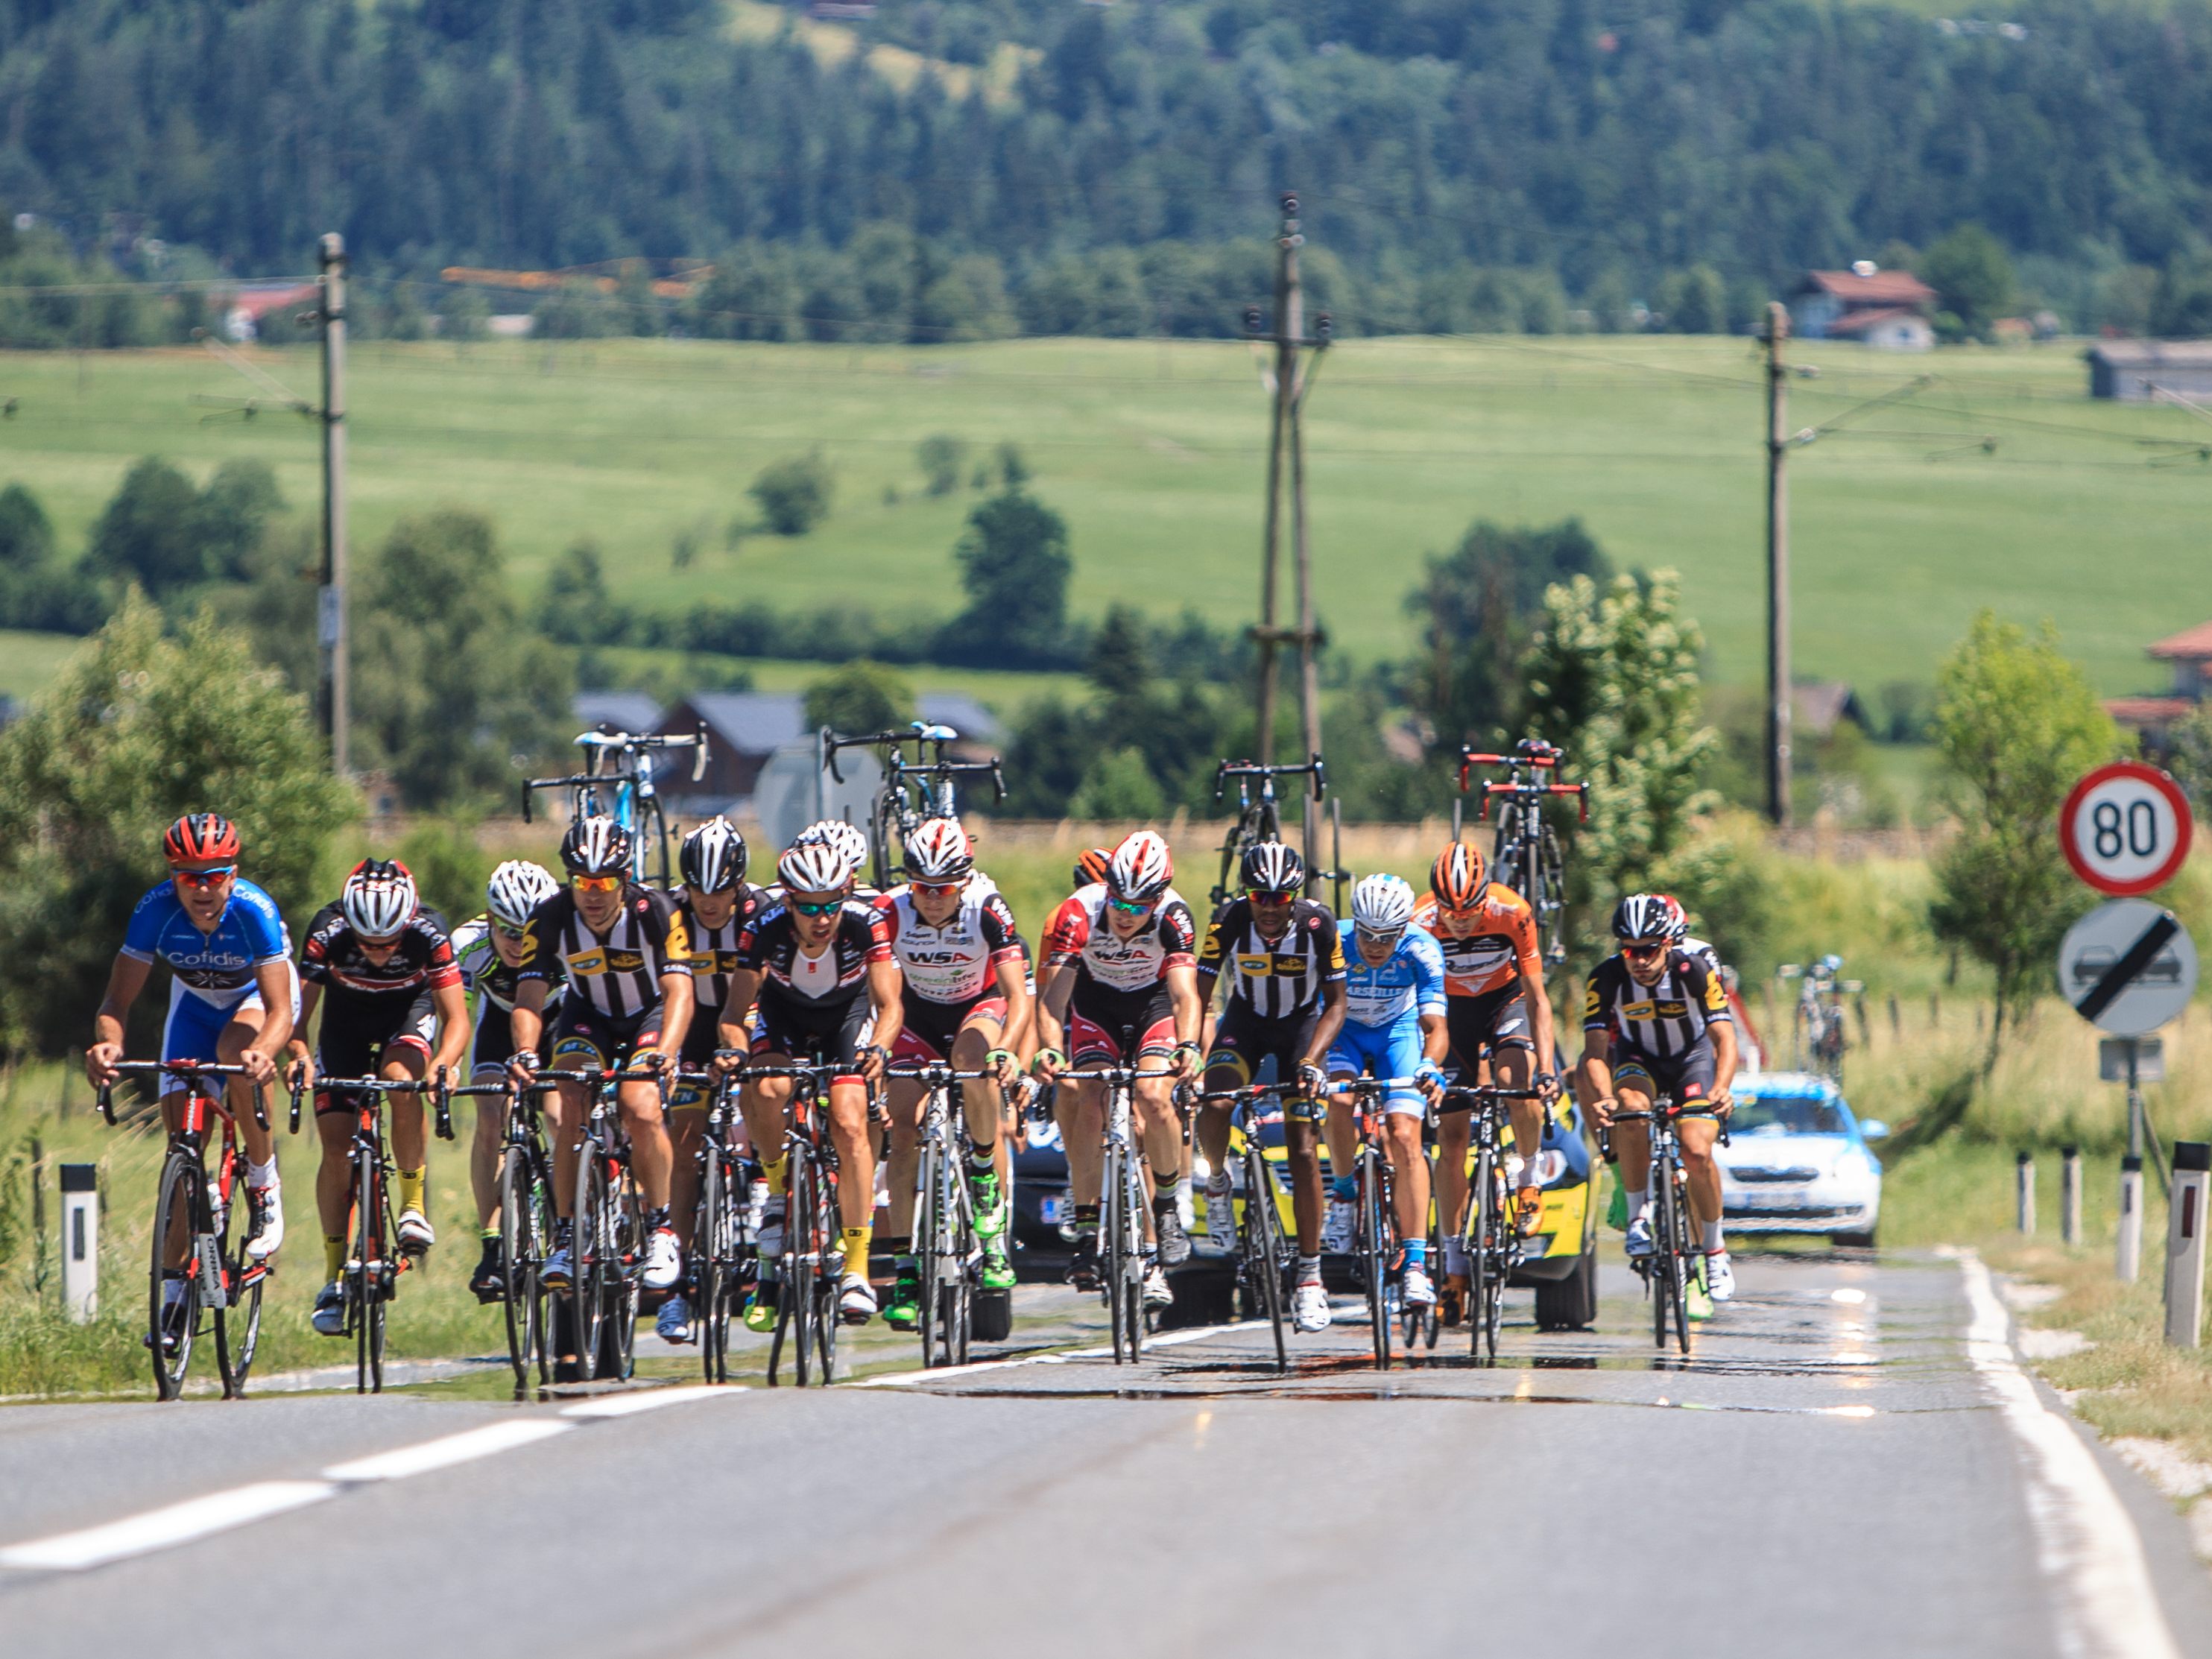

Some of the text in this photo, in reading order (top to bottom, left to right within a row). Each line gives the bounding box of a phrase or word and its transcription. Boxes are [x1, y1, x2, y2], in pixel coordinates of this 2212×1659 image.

[2093, 799, 2158, 859] 80
[167, 950, 246, 967] Cofidis
[907, 952, 973, 964] WSA
[1093, 949, 1153, 961] WSA
[1345, 985, 1404, 997] ARSEILLE
[206, 1237, 221, 1290] ORBEA
